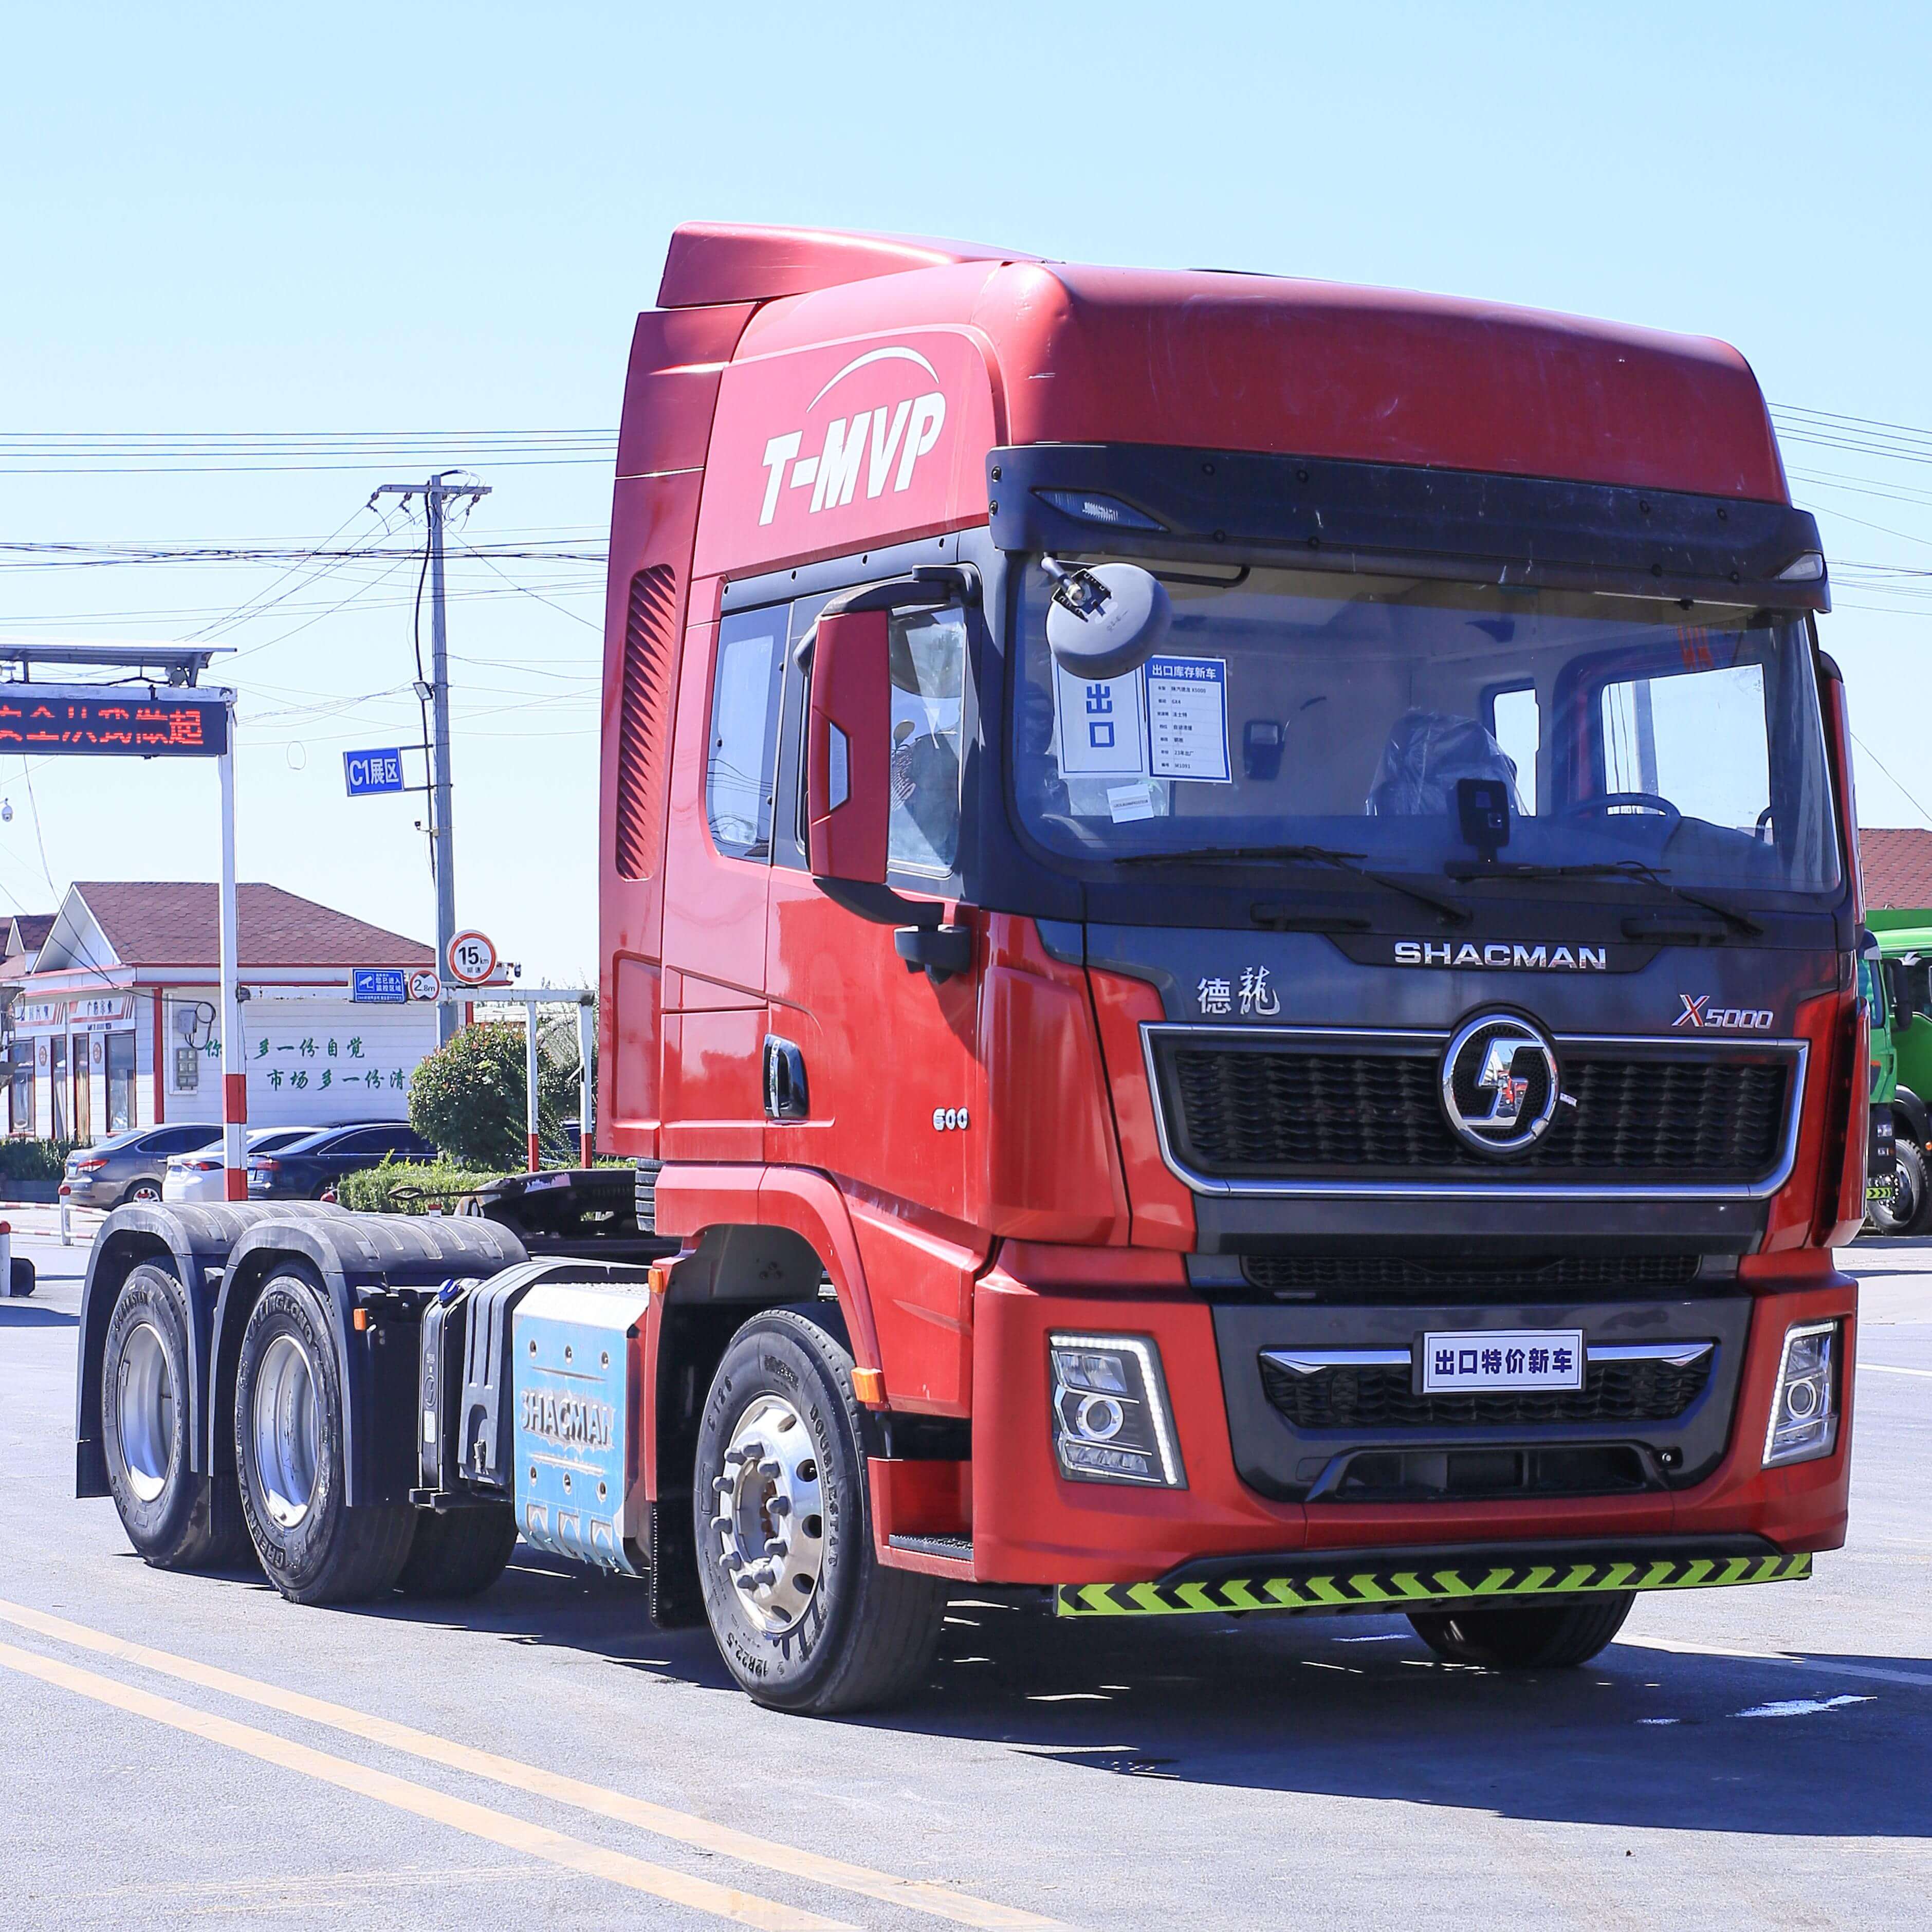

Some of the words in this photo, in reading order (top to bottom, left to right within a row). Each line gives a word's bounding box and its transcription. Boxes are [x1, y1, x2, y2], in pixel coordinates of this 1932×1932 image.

[759, 391, 946, 526] T-MVP
[1152, 664, 1217, 679] 出口库存新车
[1086, 684, 1115, 748] 出口
[349, 758, 399, 786] C1展区
[458, 946, 479, 965] 15
[1393, 941, 1607, 970] SHACMAN
[414, 979, 435, 992] 2.8m
[1671, 993, 1774, 1030] X5000
[932, 1107, 969, 1132] 600
[1434, 1348, 1573, 1375] 出口特价新车
[809, 1403, 839, 1567] DOUBLESTAR
